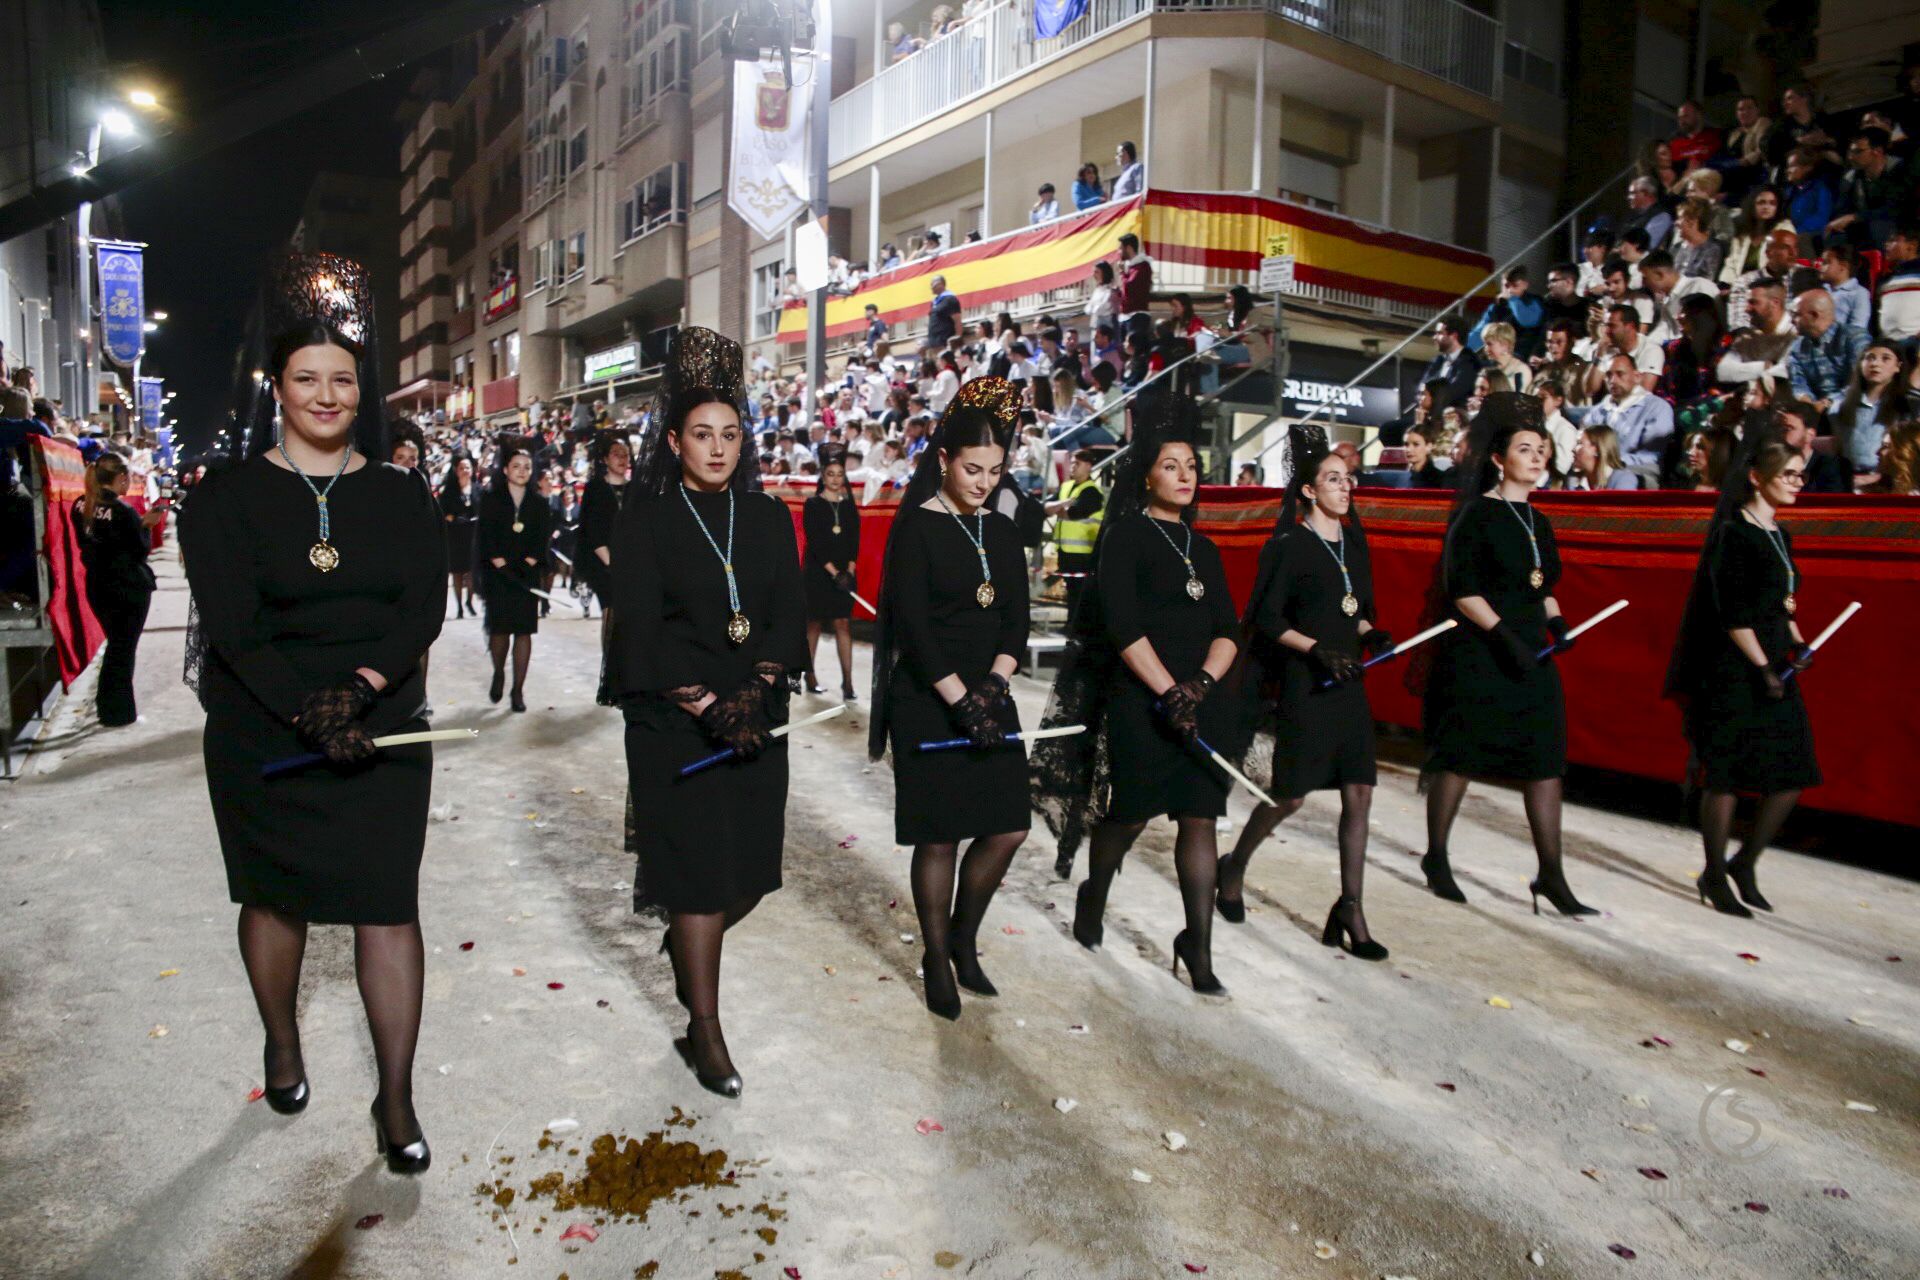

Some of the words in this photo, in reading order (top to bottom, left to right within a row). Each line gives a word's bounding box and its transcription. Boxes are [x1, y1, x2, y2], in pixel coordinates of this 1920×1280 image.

[752, 136, 787, 151] PASO
[1271, 244, 1284, 257] 36
[75, 500, 112, 521] PRSA
